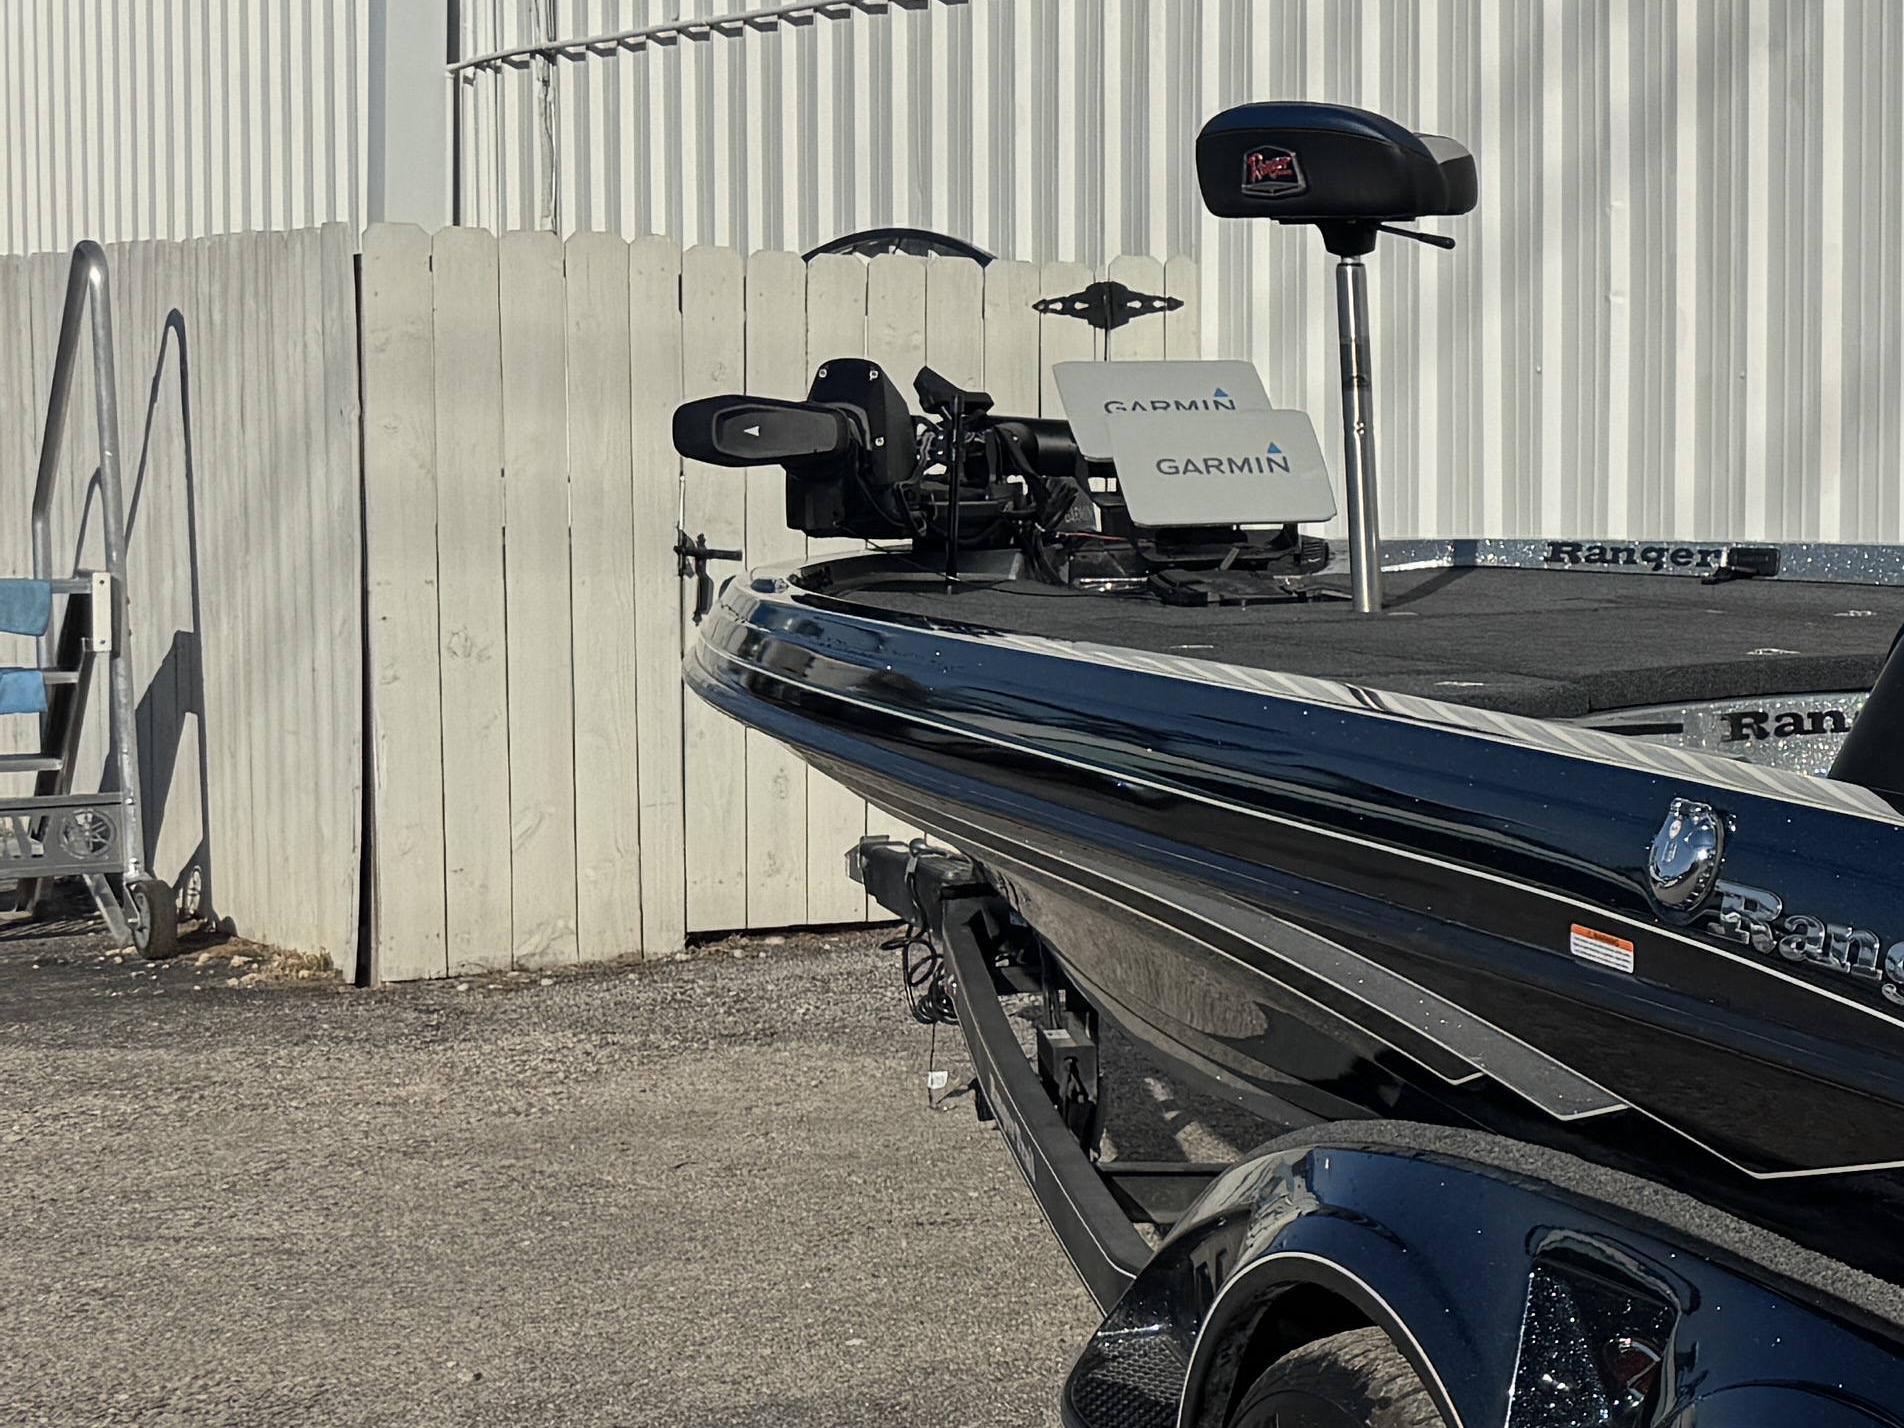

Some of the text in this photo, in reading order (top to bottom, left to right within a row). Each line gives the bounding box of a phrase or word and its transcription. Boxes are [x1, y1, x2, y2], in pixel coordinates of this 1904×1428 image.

[1104, 399, 1237, 414] GARMIN
[1156, 456, 1291, 476] GARMIN
[1543, 542, 1723, 571] Ranger
[1720, 708, 1860, 743] Ran
